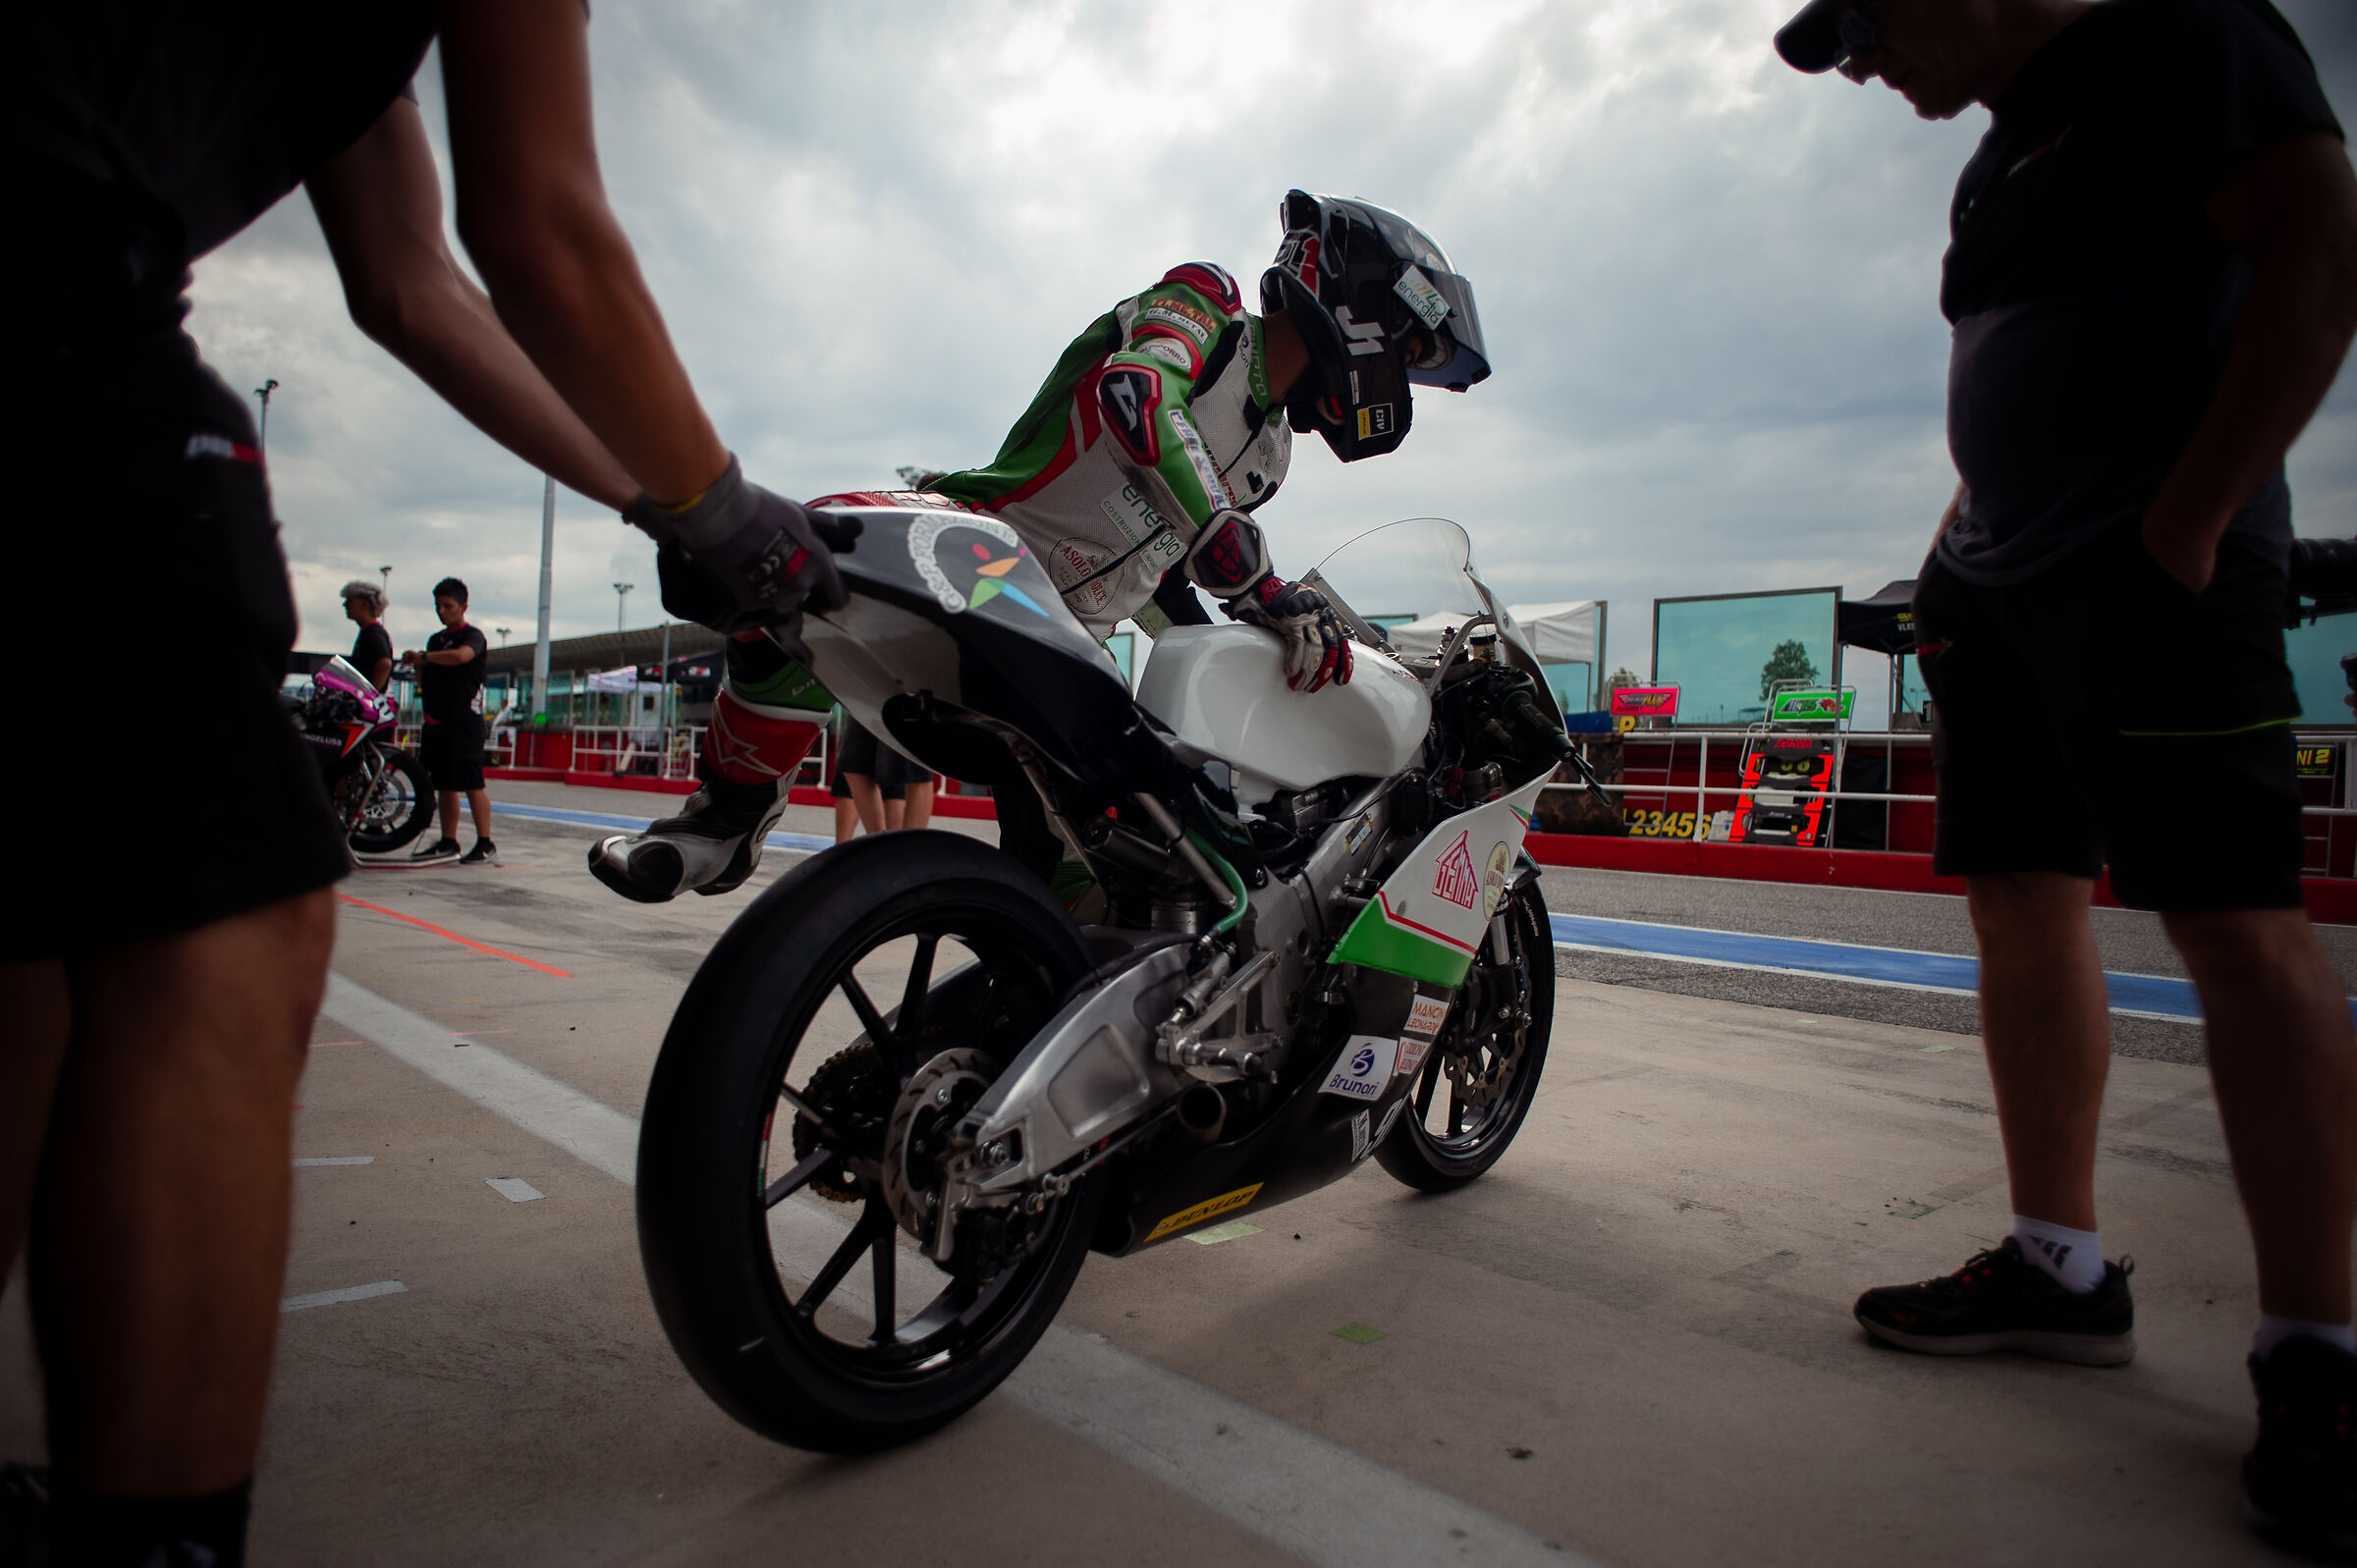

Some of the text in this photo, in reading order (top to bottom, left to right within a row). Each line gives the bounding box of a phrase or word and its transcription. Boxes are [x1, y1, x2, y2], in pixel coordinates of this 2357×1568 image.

[1397, 280, 1439, 324] energia
[1375, 408, 1385, 430] CIV
[1103, 500, 1142, 546] COSTRUZION
[1061, 545, 1093, 578] ASOLO
[2314, 748, 2330, 765] 2
[1329, 1074, 1380, 1097] Brunori
[1172, 1189, 1256, 1227] DUNLOP
